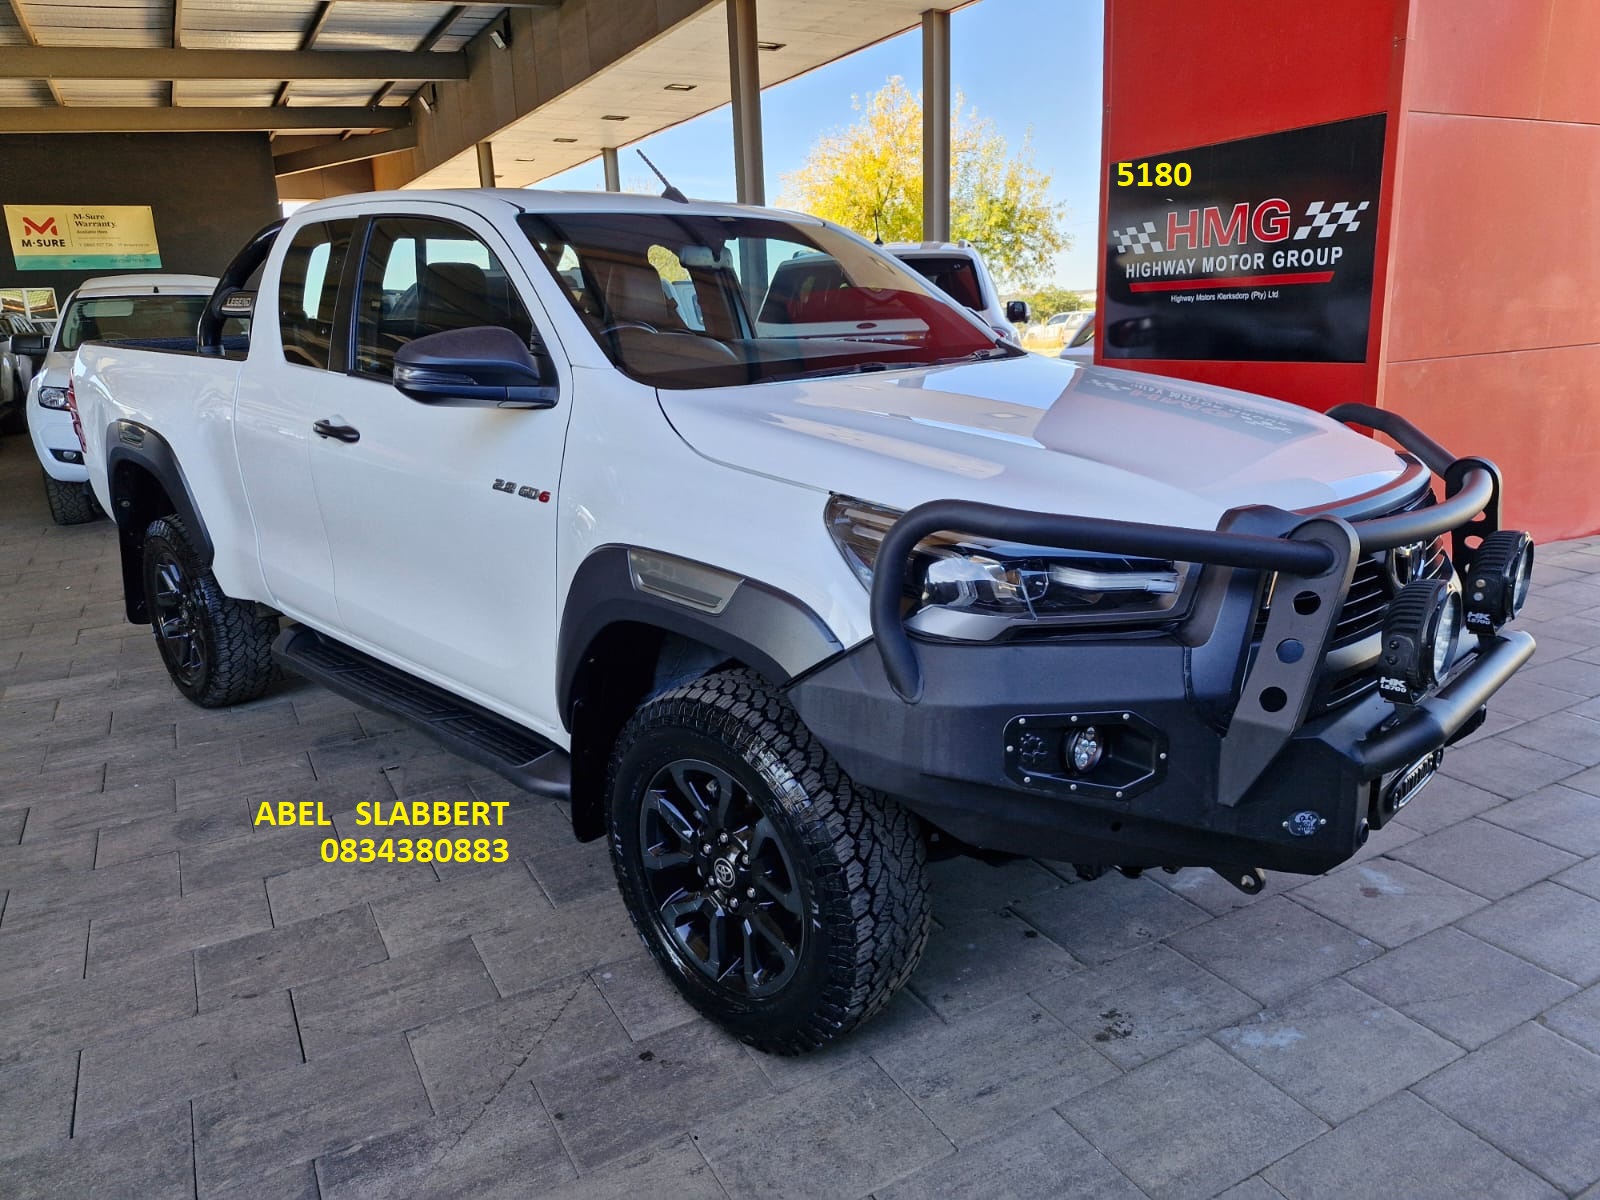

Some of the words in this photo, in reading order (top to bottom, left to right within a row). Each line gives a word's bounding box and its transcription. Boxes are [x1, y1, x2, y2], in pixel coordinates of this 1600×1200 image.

[1166, 198, 1291, 251] HMG
[1125, 258, 1196, 279] HIGHWAY
[1202, 252, 1264, 273] MOTOR
[1272, 246, 1343, 268] GROUP
[1170, 294, 1194, 303] Highway
[1196, 293, 1216, 302] Motors
[1217, 291, 1249, 301] Klerksdorp
[1251, 291, 1267, 300] (Pty)
[1268, 290, 1279, 299] Ltd
